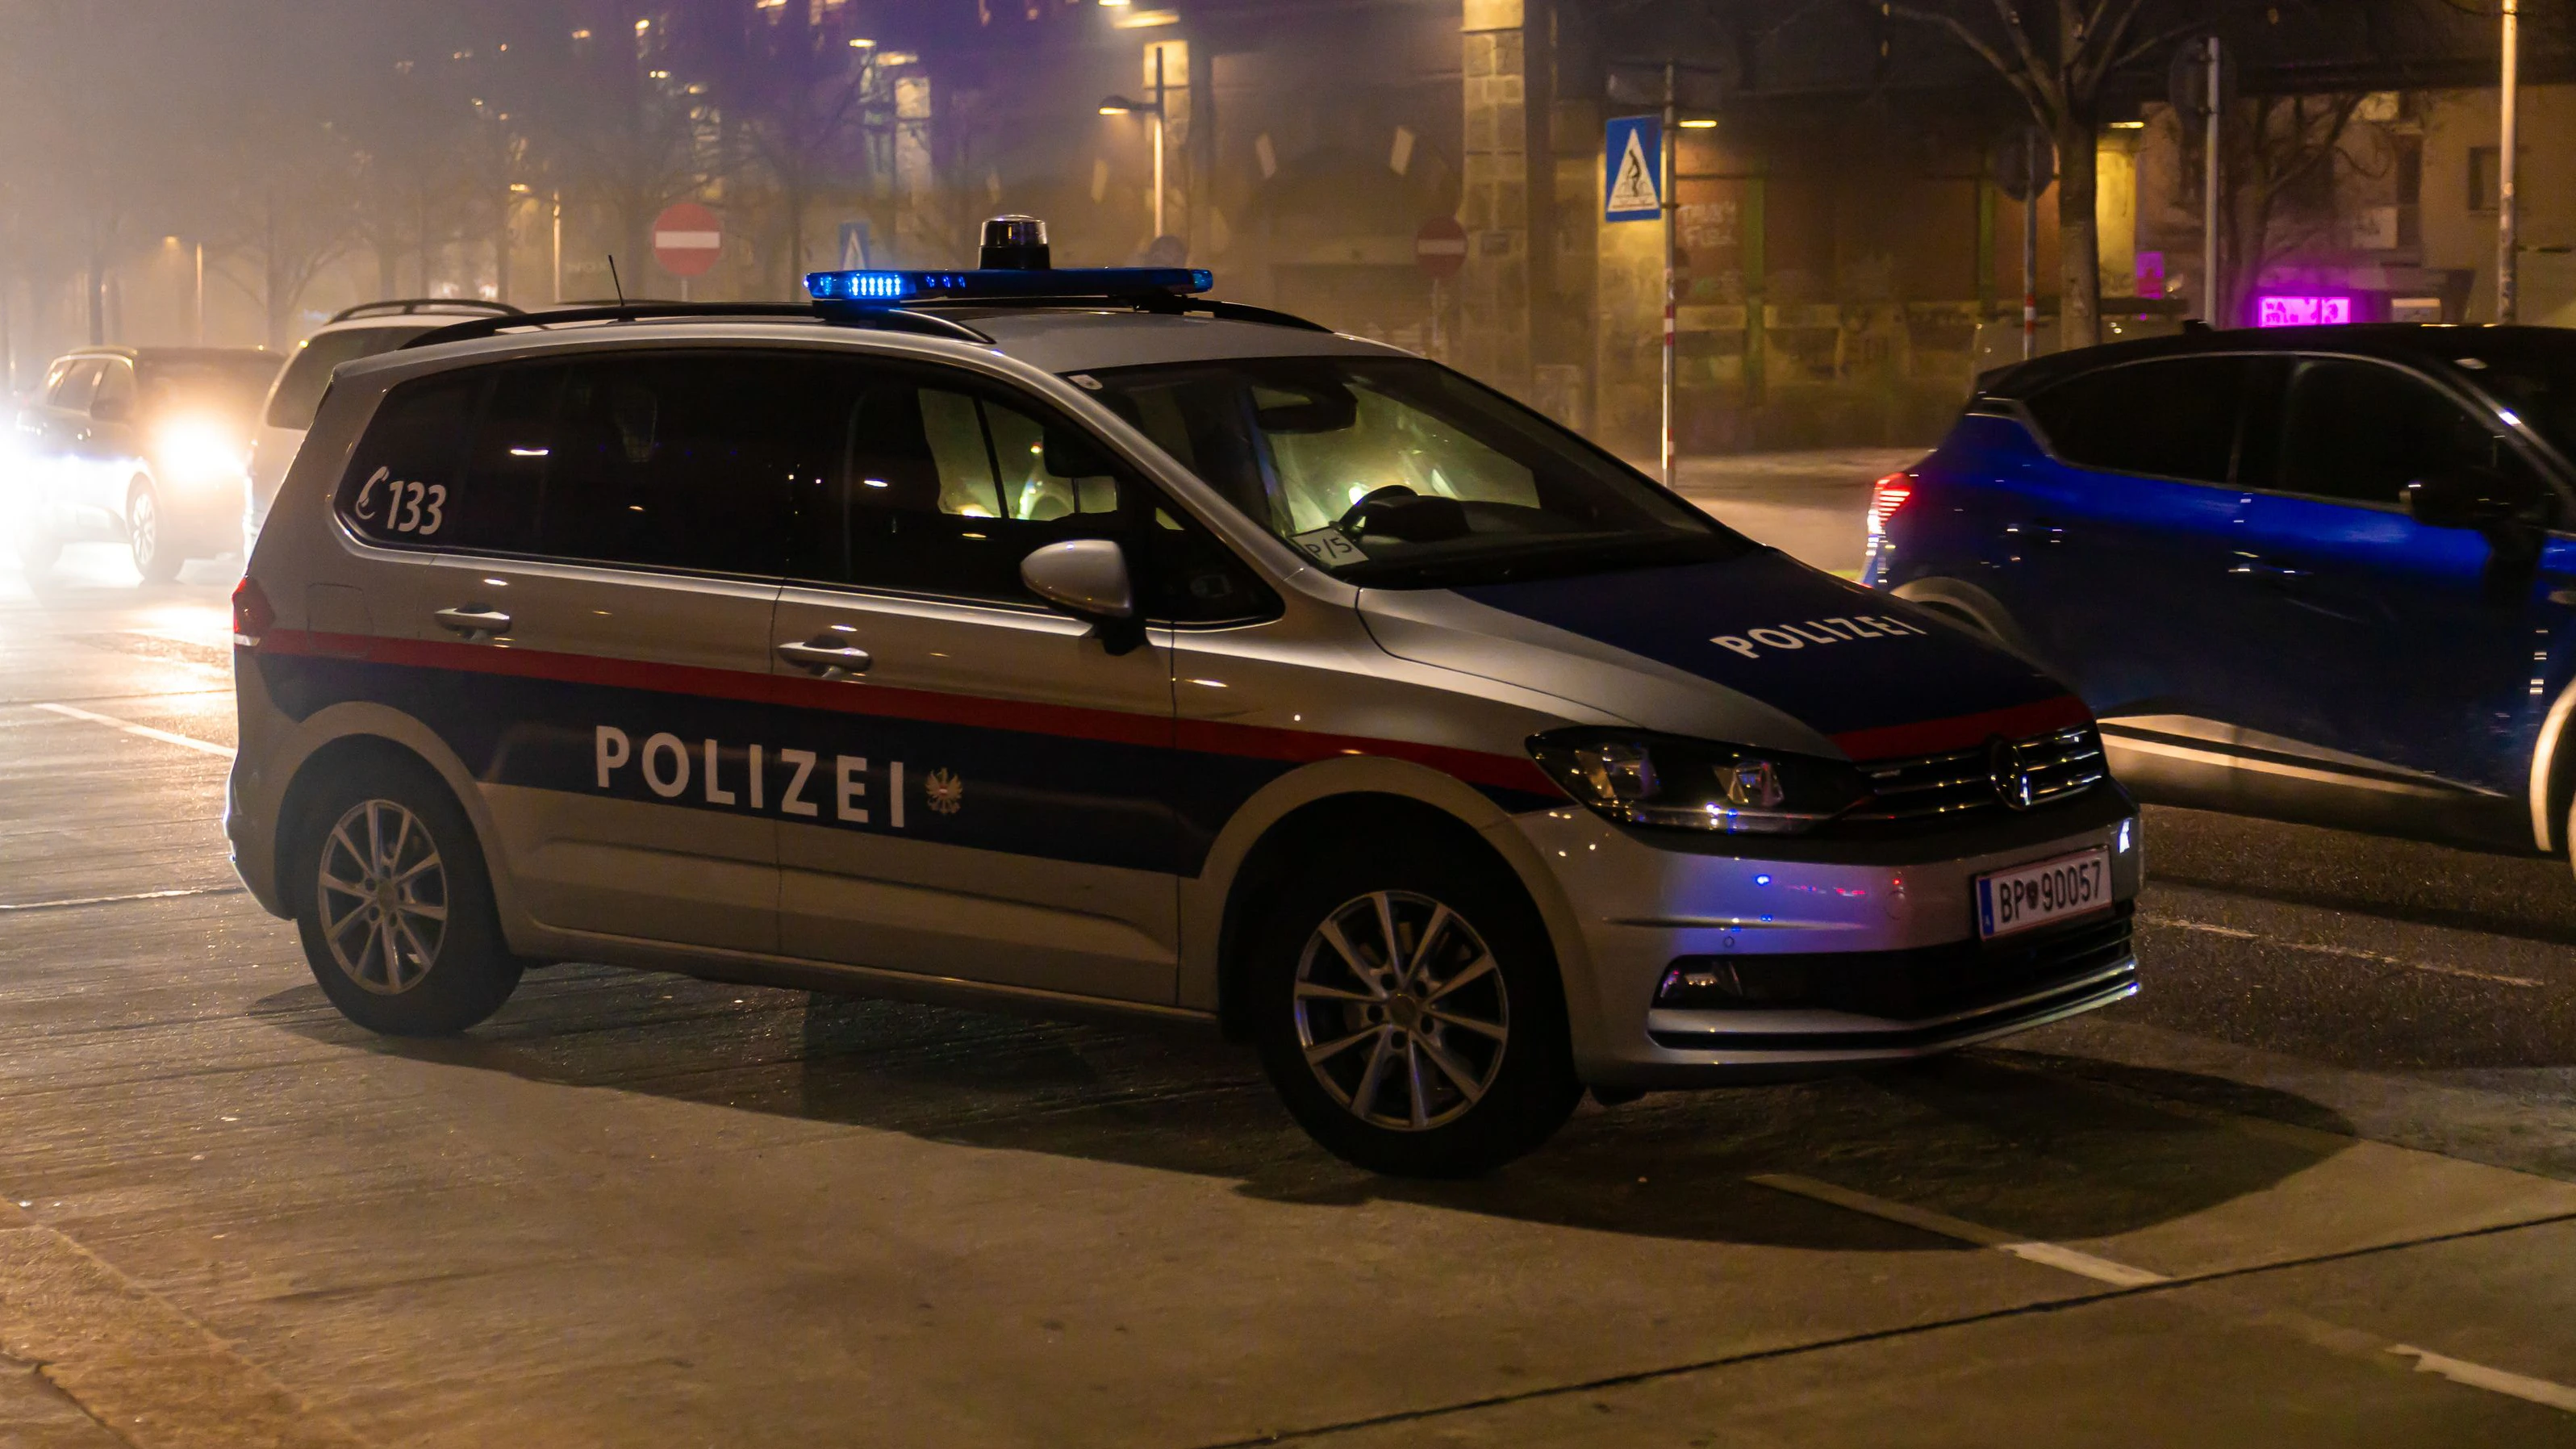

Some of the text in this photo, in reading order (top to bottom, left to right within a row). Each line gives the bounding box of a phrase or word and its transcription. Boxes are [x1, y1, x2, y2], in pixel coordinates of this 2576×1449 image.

[386, 480, 447, 536] 133
[1710, 616, 1927, 659] POLIZEI
[595, 724, 905, 829] POLIZEI
[1999, 879, 2024, 923] BP
[2042, 861, 2101, 911] 90057
